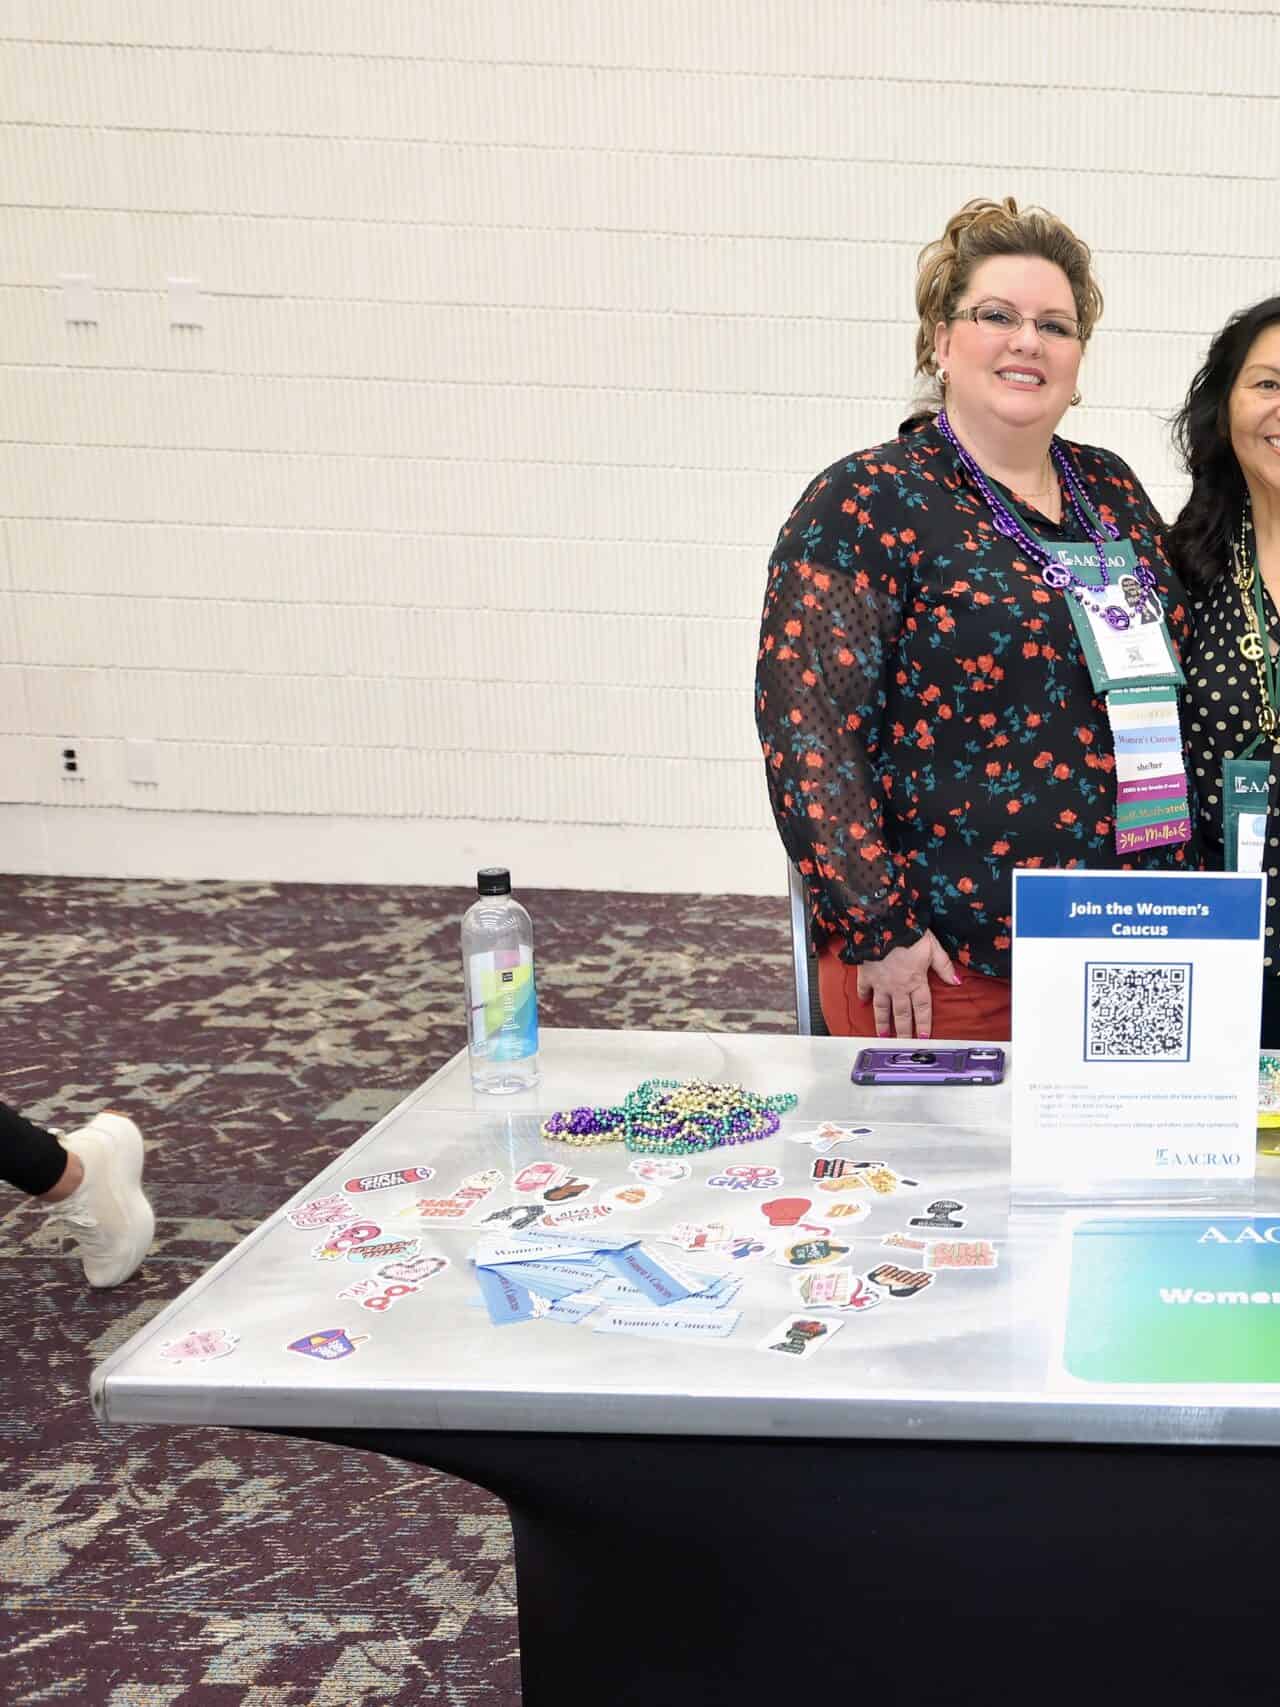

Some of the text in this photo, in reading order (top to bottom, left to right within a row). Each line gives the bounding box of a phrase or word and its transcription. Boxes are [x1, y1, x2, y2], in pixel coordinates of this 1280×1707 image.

[1072, 554, 1126, 568] AACAO
[1069, 902, 1210, 918] Join the Women's
[1111, 923, 1169, 936] Caucus
[1172, 1152, 1241, 1166] AACRAO
